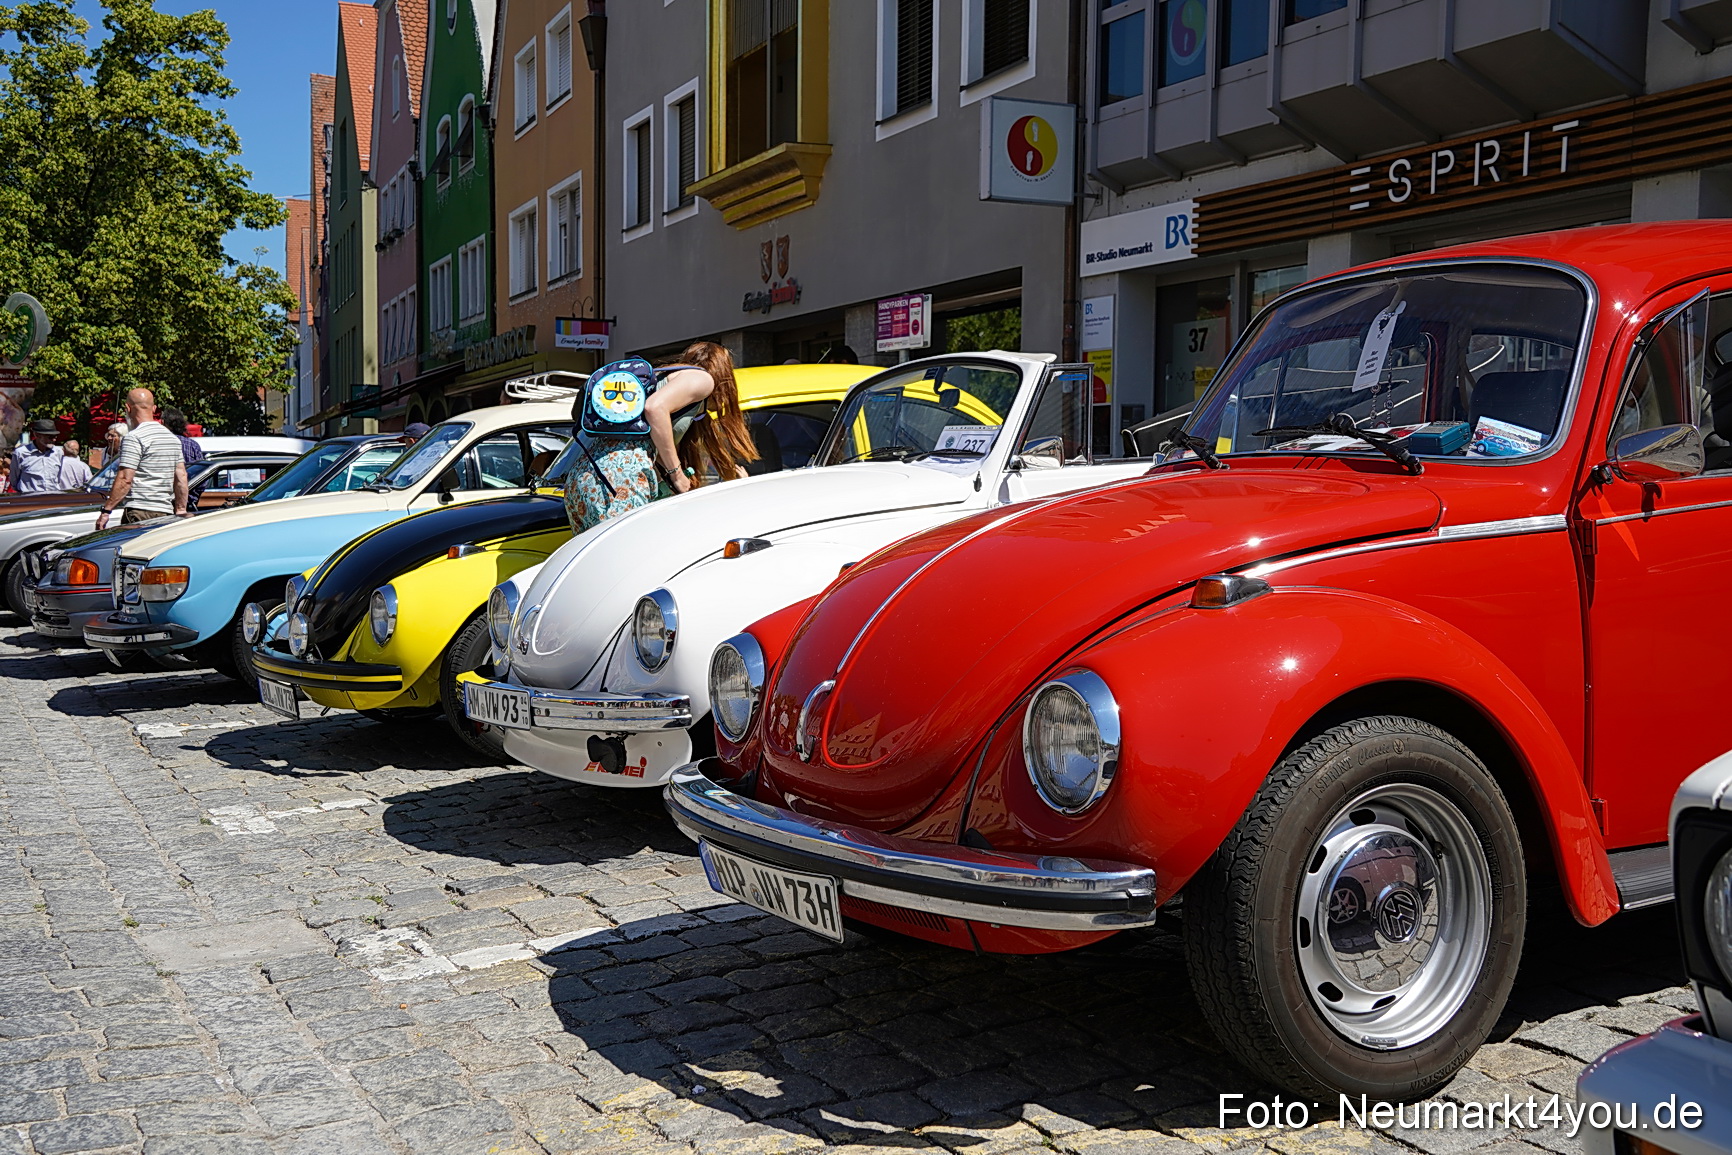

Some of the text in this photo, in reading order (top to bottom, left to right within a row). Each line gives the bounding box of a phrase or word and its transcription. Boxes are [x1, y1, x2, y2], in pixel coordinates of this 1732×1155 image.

[1349, 120, 1579, 210] ESPRIT
[1165, 214, 1190, 249] BR
[1086, 242, 1153, 264] BR-Studio Neumarkt
[1085, 303, 1093, 315] BR
[585, 337, 604, 347] family
[1188, 327, 1208, 353] 37
[962, 439, 986, 453] 237
[468, 687, 519, 723] NM VW 93
[522, 716, 528, 725] 10
[1315, 757, 1354, 794] SPRINT
[709, 849, 837, 932] HIP VW 73H
